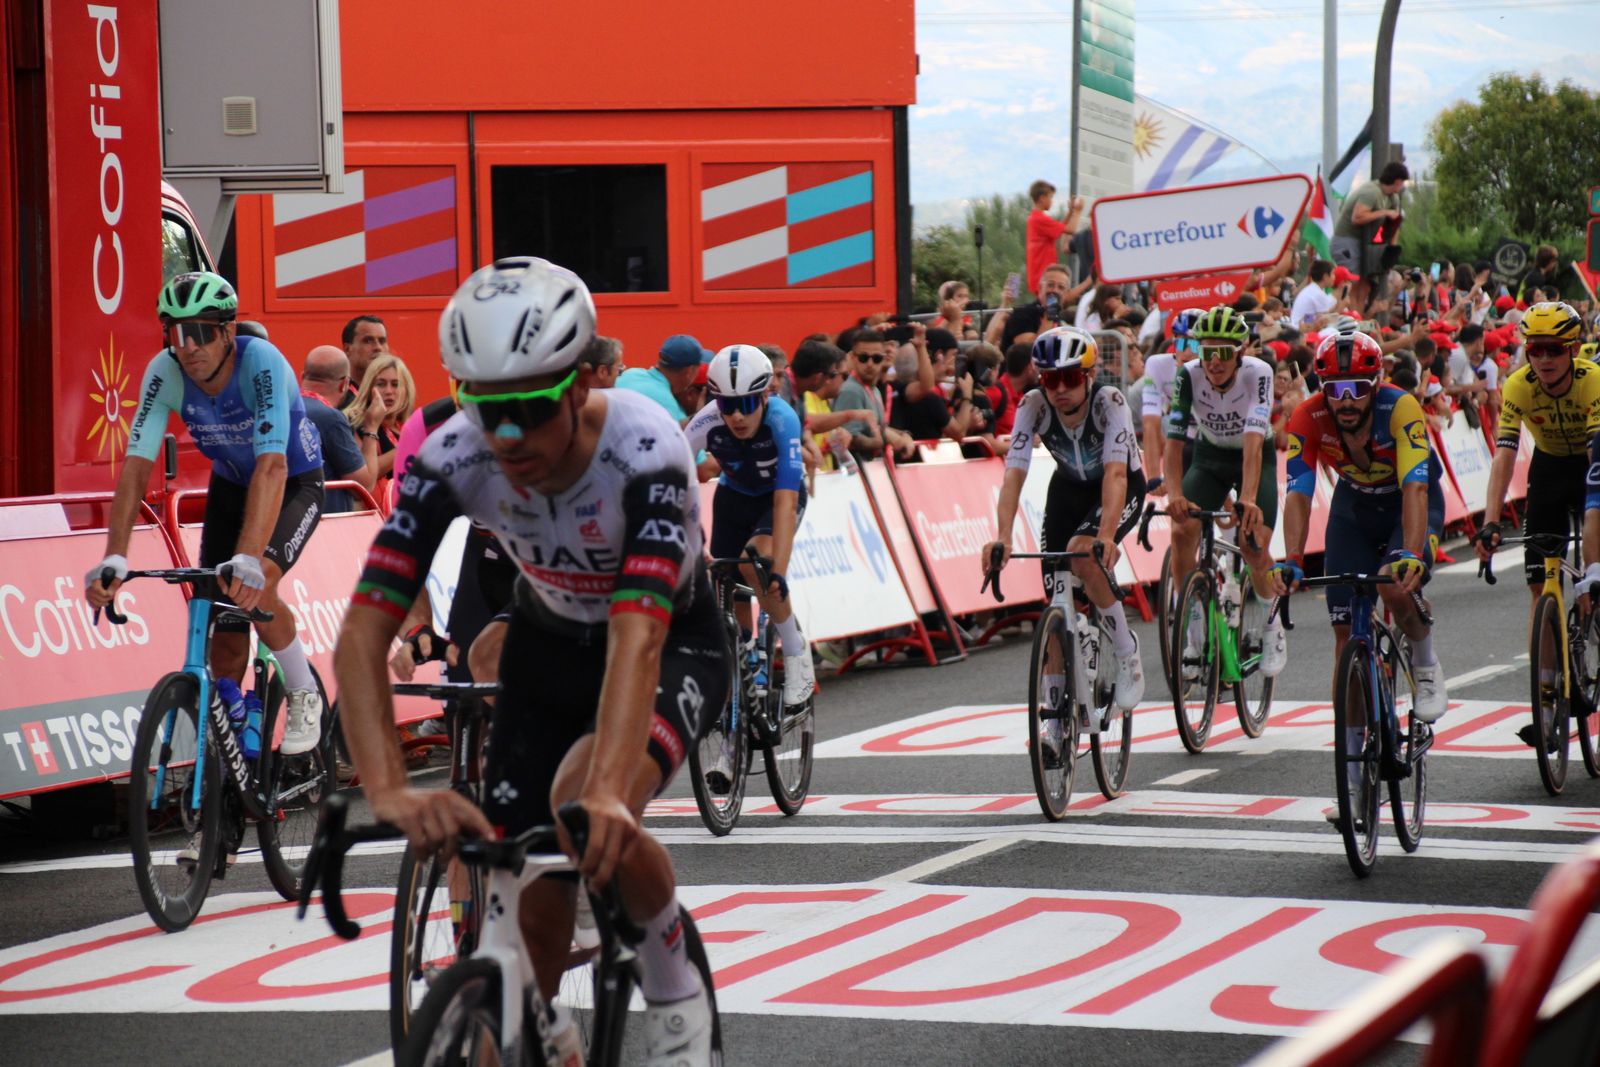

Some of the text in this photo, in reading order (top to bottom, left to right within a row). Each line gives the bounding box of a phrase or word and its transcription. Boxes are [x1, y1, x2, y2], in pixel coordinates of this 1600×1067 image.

[88, 4, 124, 314] Cofid
[1111, 221, 1227, 250] Carrefour
[1160, 287, 1210, 301] Carrefour
[136, 375, 163, 428] DECATHLON
[197, 416, 255, 432] DECATHLON
[1207, 411, 1241, 421] CAJA
[291, 502, 319, 550] DECATHLON
[917, 504, 992, 561] Carrefour
[508, 540, 619, 573] UAE
[46, 704, 165, 769] TISSO
[211, 691, 249, 792] VAN RYSEL
